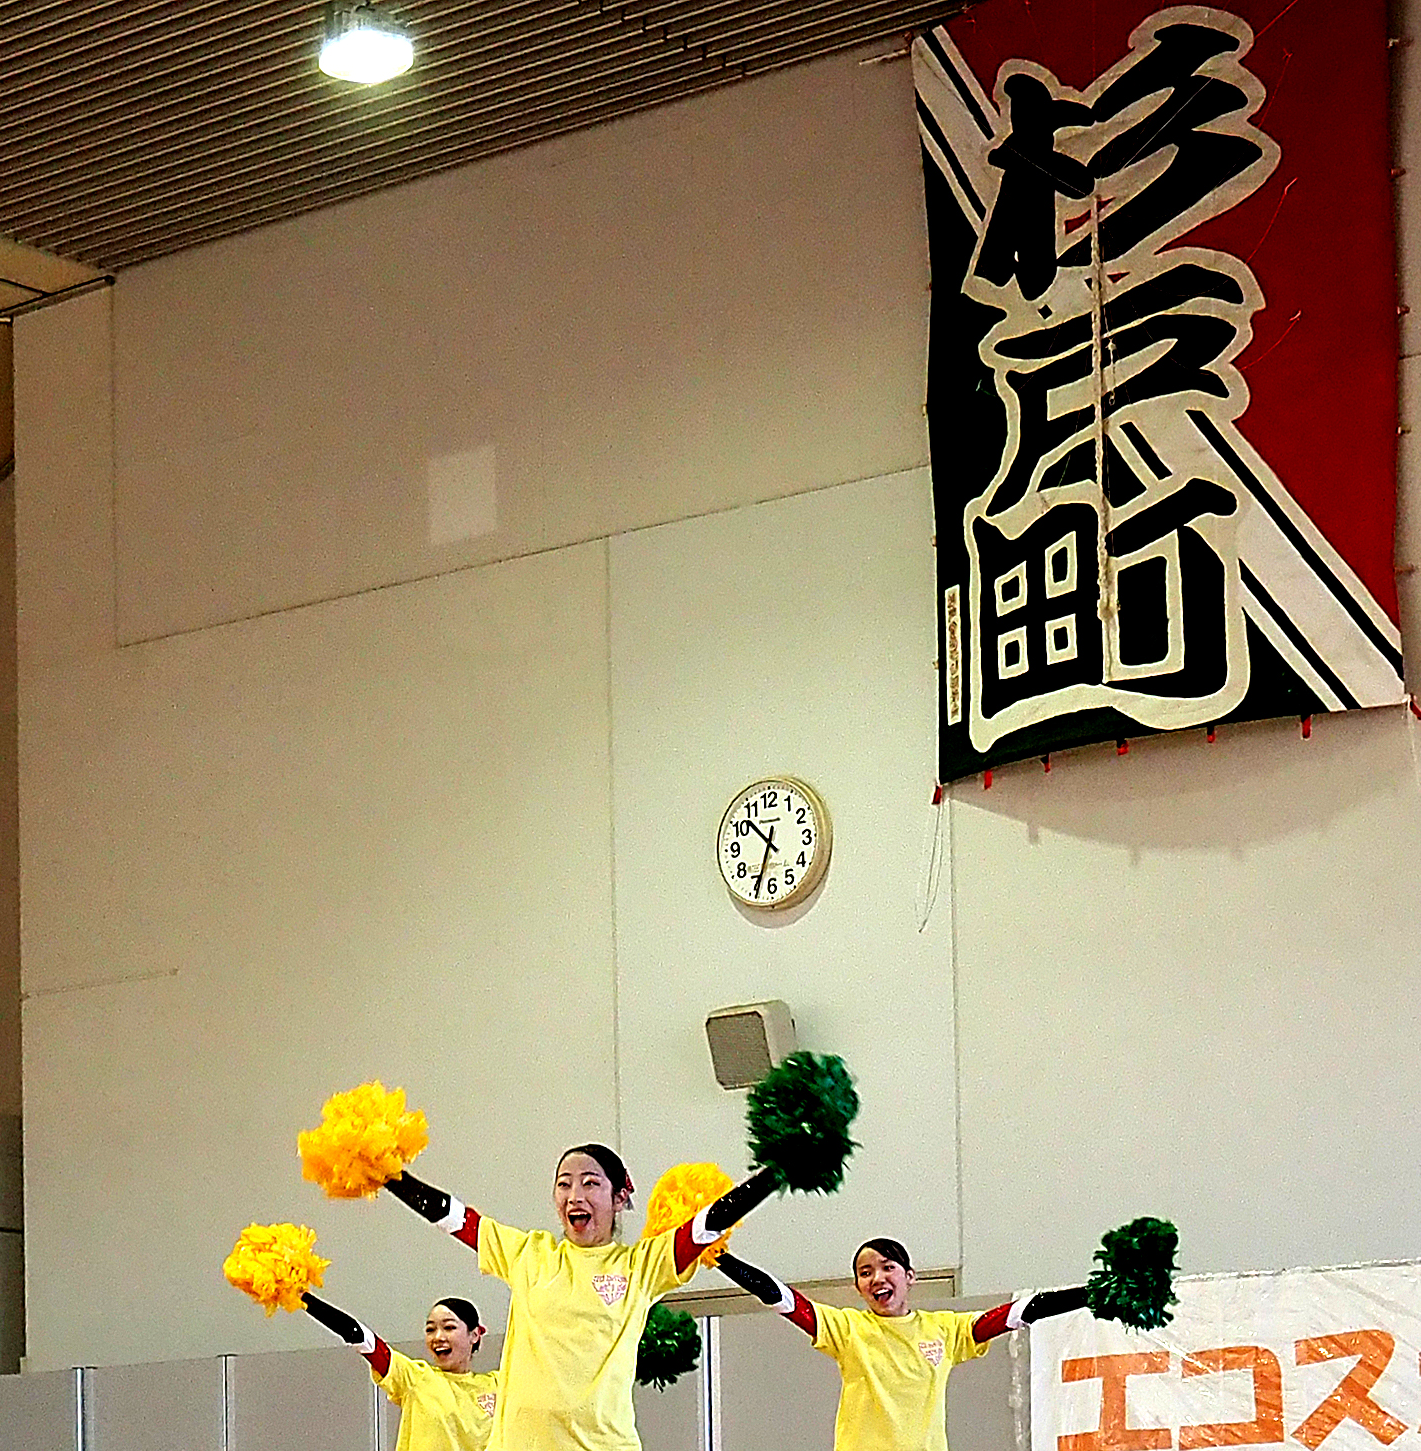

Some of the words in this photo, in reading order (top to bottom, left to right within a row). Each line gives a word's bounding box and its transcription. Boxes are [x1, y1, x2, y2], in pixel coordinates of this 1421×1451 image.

[970, 15, 1272, 725] 杉戸町
[760, 791, 778, 809] 12
[783, 795, 792, 812] 1
[744, 801, 758, 819] 11
[795, 807, 806, 825] 2
[732, 819, 750, 838] 10
[801, 828, 812, 846] 3
[730, 841, 741, 859] 9
[795, 851, 806, 868] 4
[736, 862, 747, 879] 8
[784, 868, 795, 885] 5
[767, 877, 778, 895] 6
